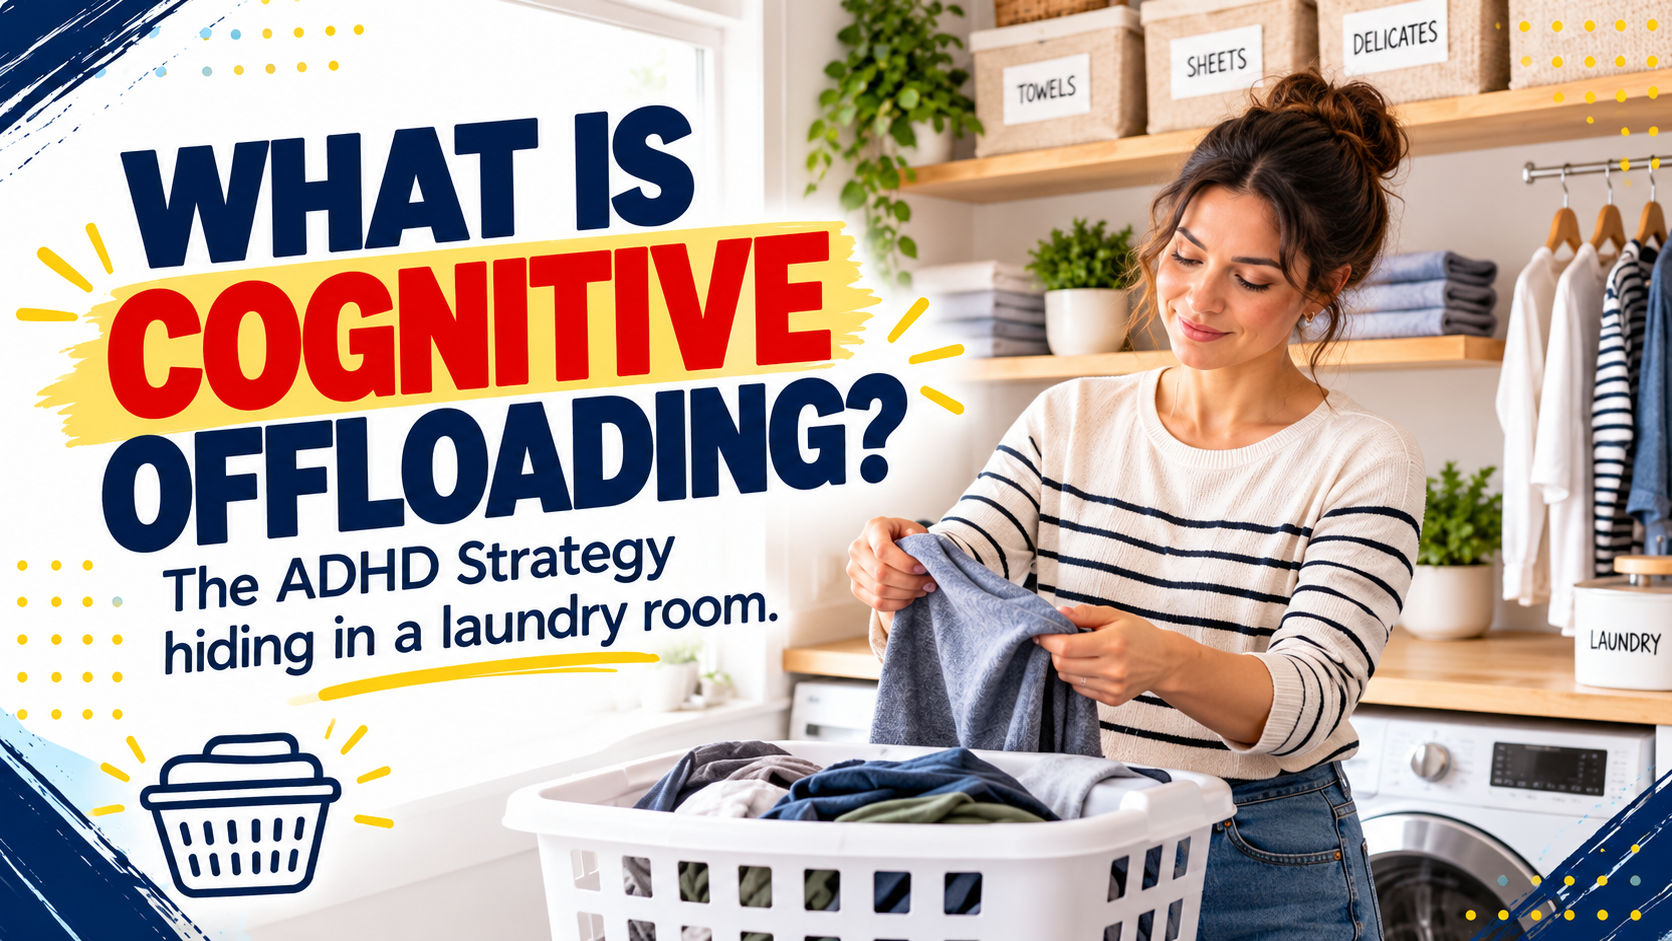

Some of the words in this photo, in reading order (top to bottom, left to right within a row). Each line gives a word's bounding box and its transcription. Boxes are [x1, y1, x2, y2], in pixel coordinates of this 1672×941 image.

[1352, 19, 1439, 56] DELICATES
[1186, 47, 1248, 78] SHEETS
[1017, 75, 1077, 105] TOWELS
[1589, 629, 1663, 656] LAUNDRY
